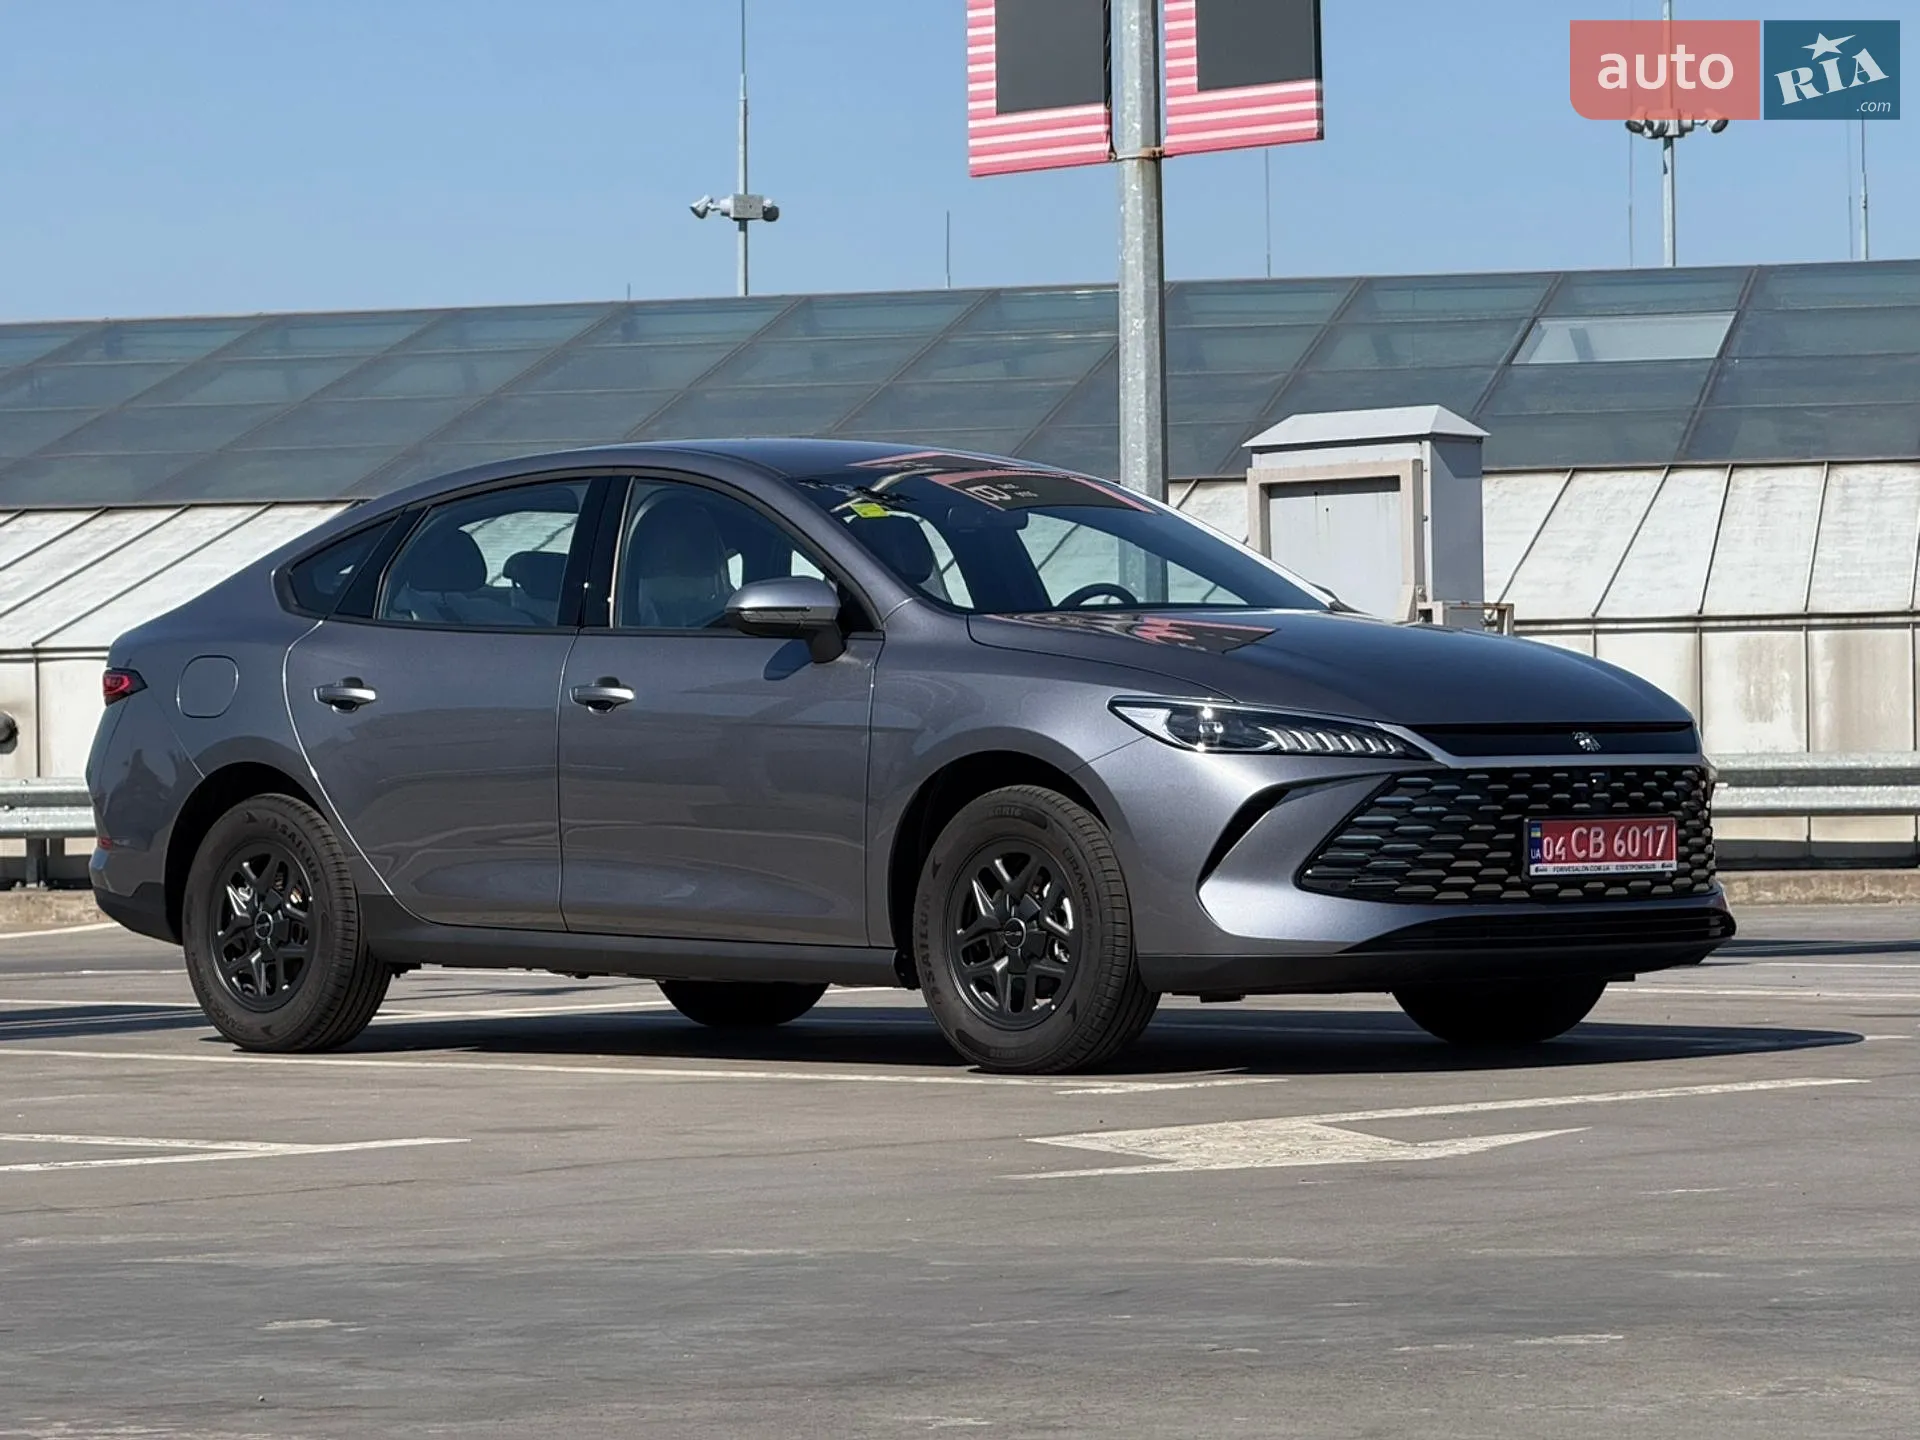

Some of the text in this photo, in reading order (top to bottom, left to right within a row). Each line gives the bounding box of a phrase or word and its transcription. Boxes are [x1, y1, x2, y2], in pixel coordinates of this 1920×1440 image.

[1530, 848, 1542, 860] UA
[1543, 825, 1669, 861] 04 CB 6017
